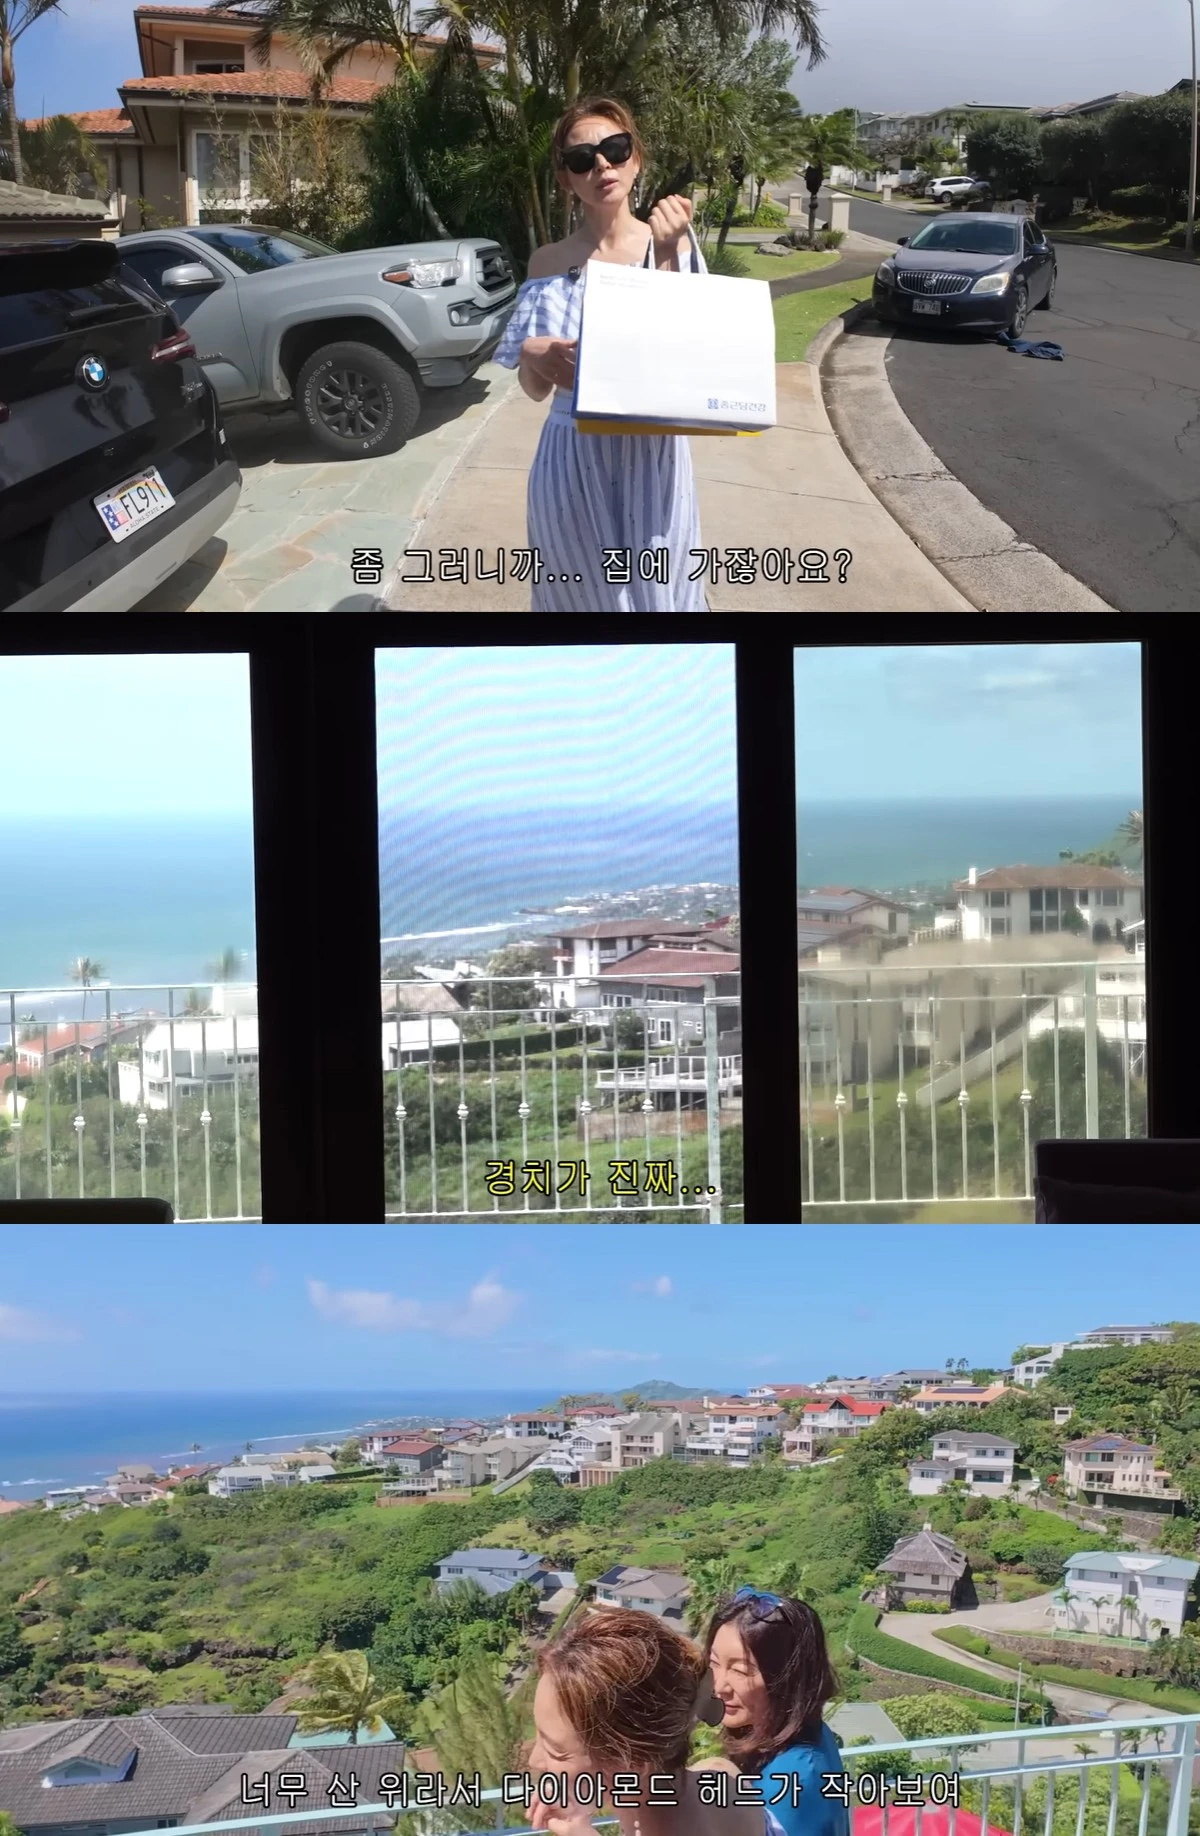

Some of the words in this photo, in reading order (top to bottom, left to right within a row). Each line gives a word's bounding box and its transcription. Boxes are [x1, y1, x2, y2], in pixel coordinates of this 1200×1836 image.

[120, 477, 166, 519] FL911
[130, 516, 145, 528] ALOHA
[145, 506, 160, 518] STATE
